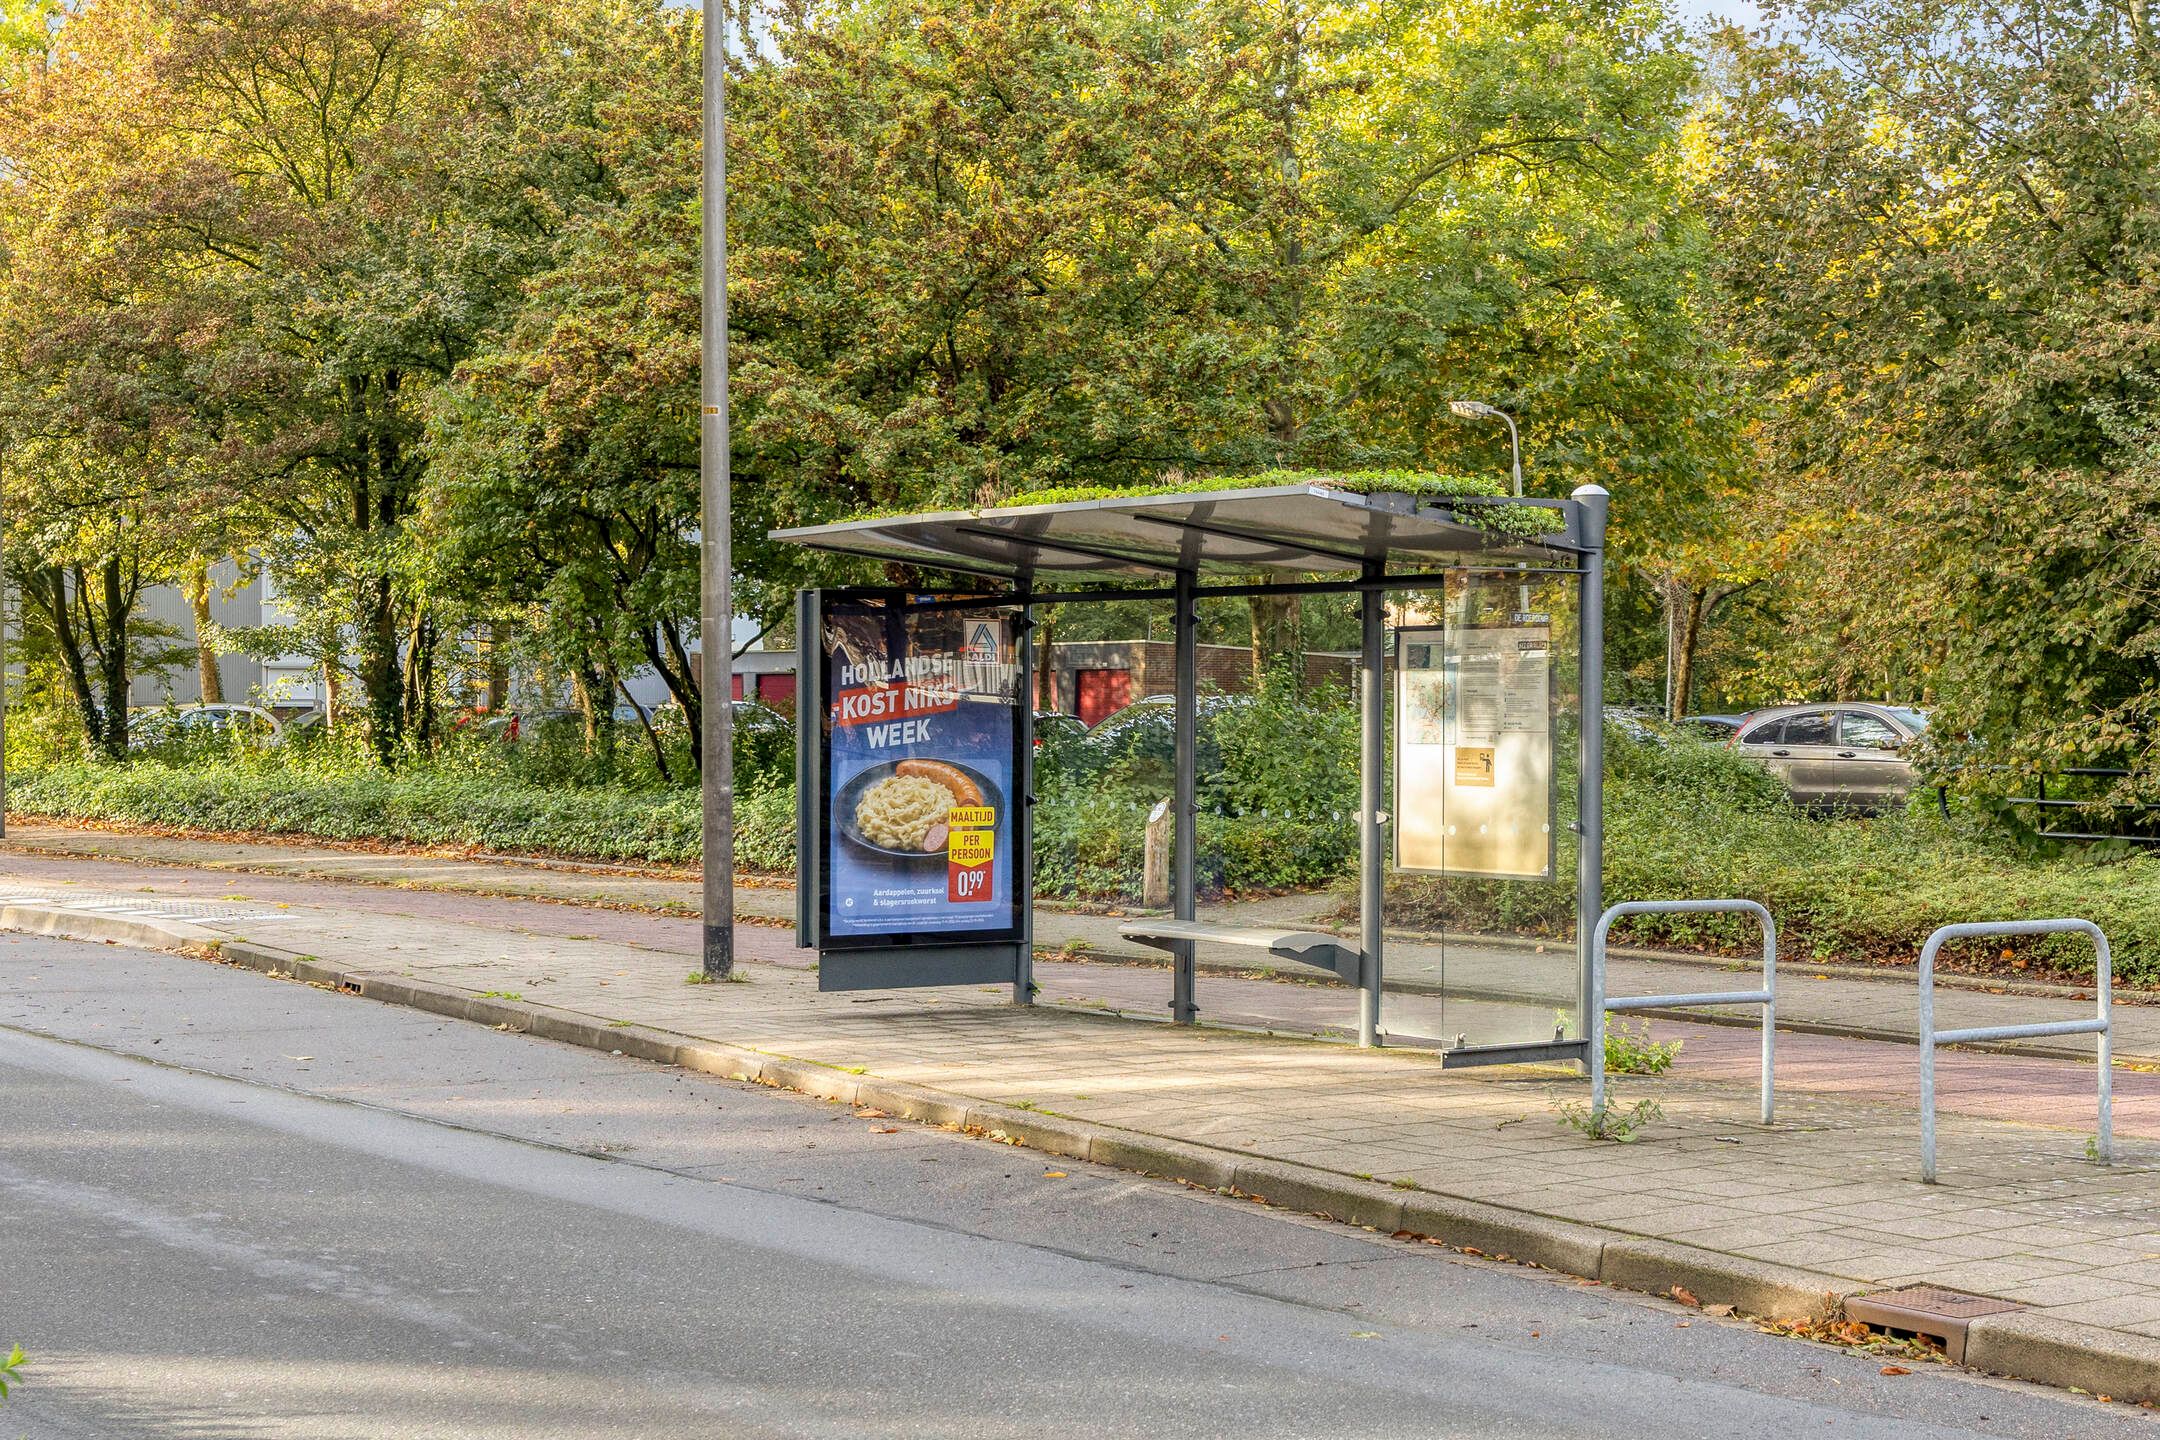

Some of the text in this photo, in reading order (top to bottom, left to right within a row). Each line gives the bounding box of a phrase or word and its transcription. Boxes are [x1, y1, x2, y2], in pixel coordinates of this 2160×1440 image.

[970, 653, 996, 663] ALDI
[841, 652, 954, 685] HOLLANDSE
[842, 682, 954, 719] KOST NIKS
[866, 718, 931, 749] WEEK
[951, 811, 993, 822] MAALTIJD
[963, 835, 980, 846] PER
[952, 848, 990, 859] PERSOON
